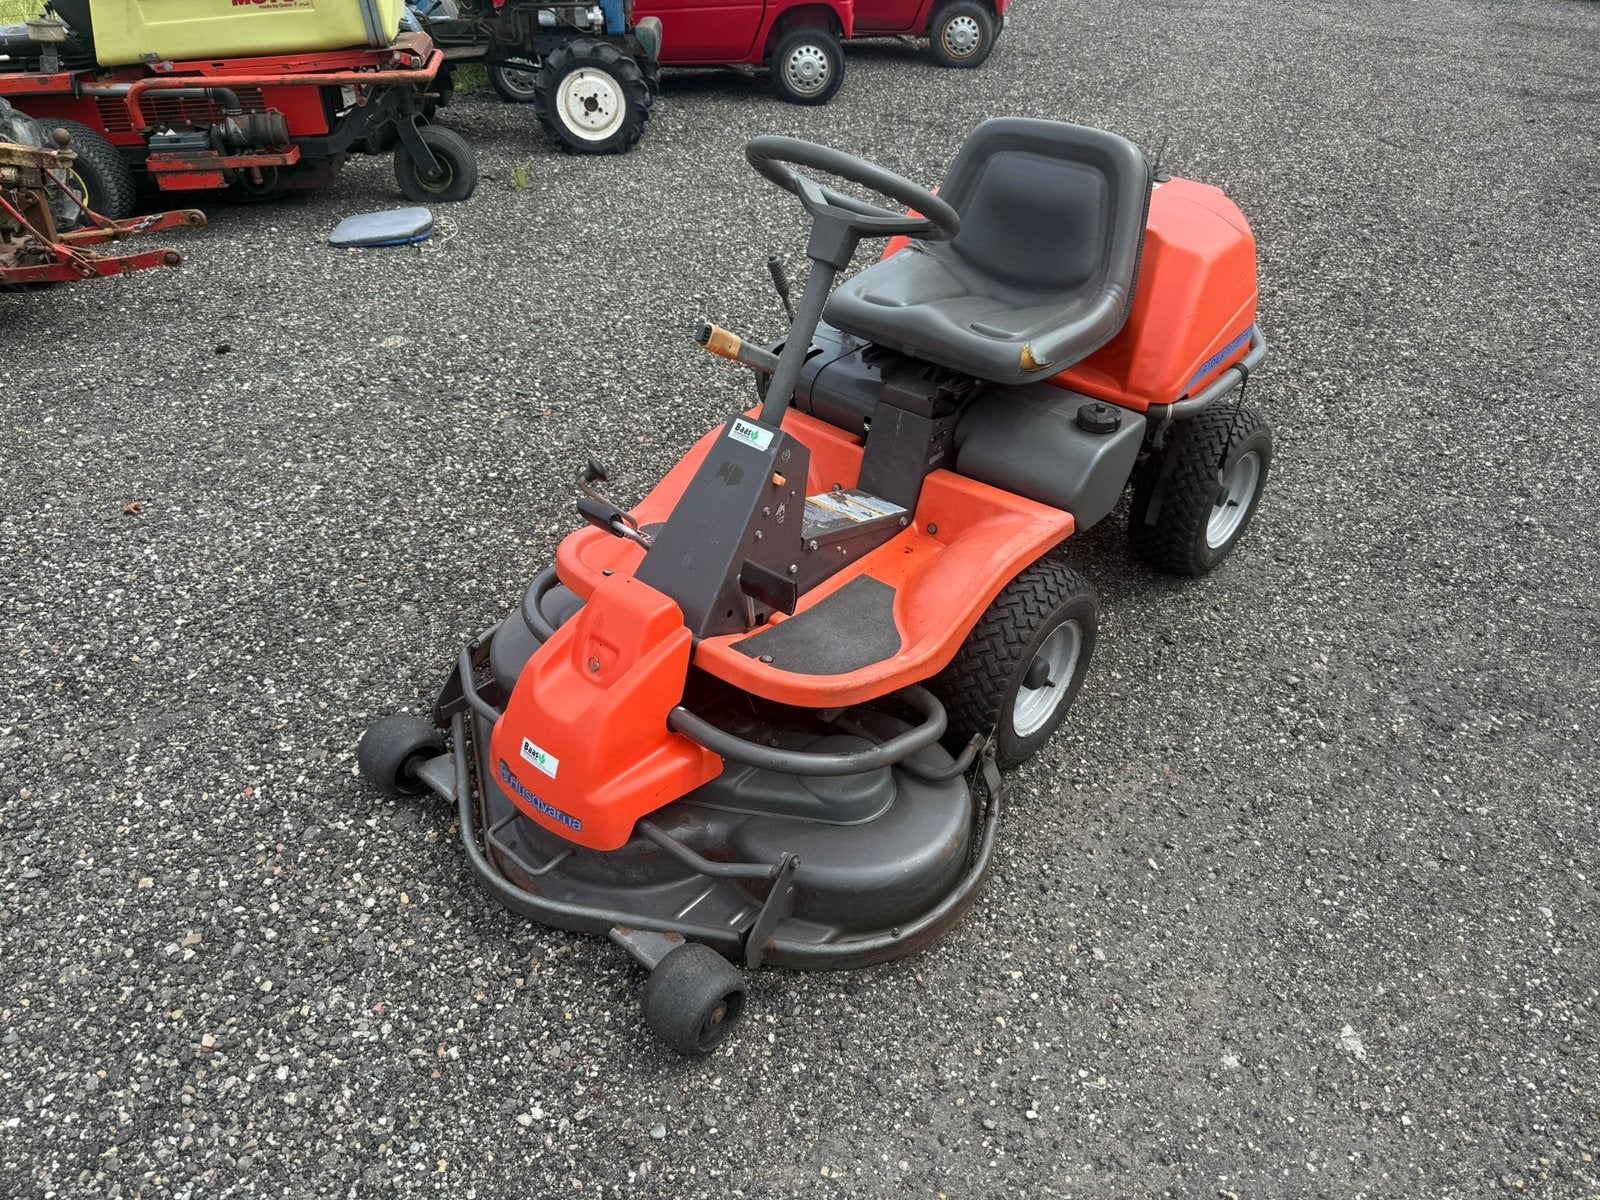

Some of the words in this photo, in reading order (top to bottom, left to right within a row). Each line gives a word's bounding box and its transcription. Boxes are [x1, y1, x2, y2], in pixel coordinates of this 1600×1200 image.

[734, 423, 752, 436] Baas
[523, 741, 539, 759] Baas
[510, 774, 582, 832] Husqvarna
